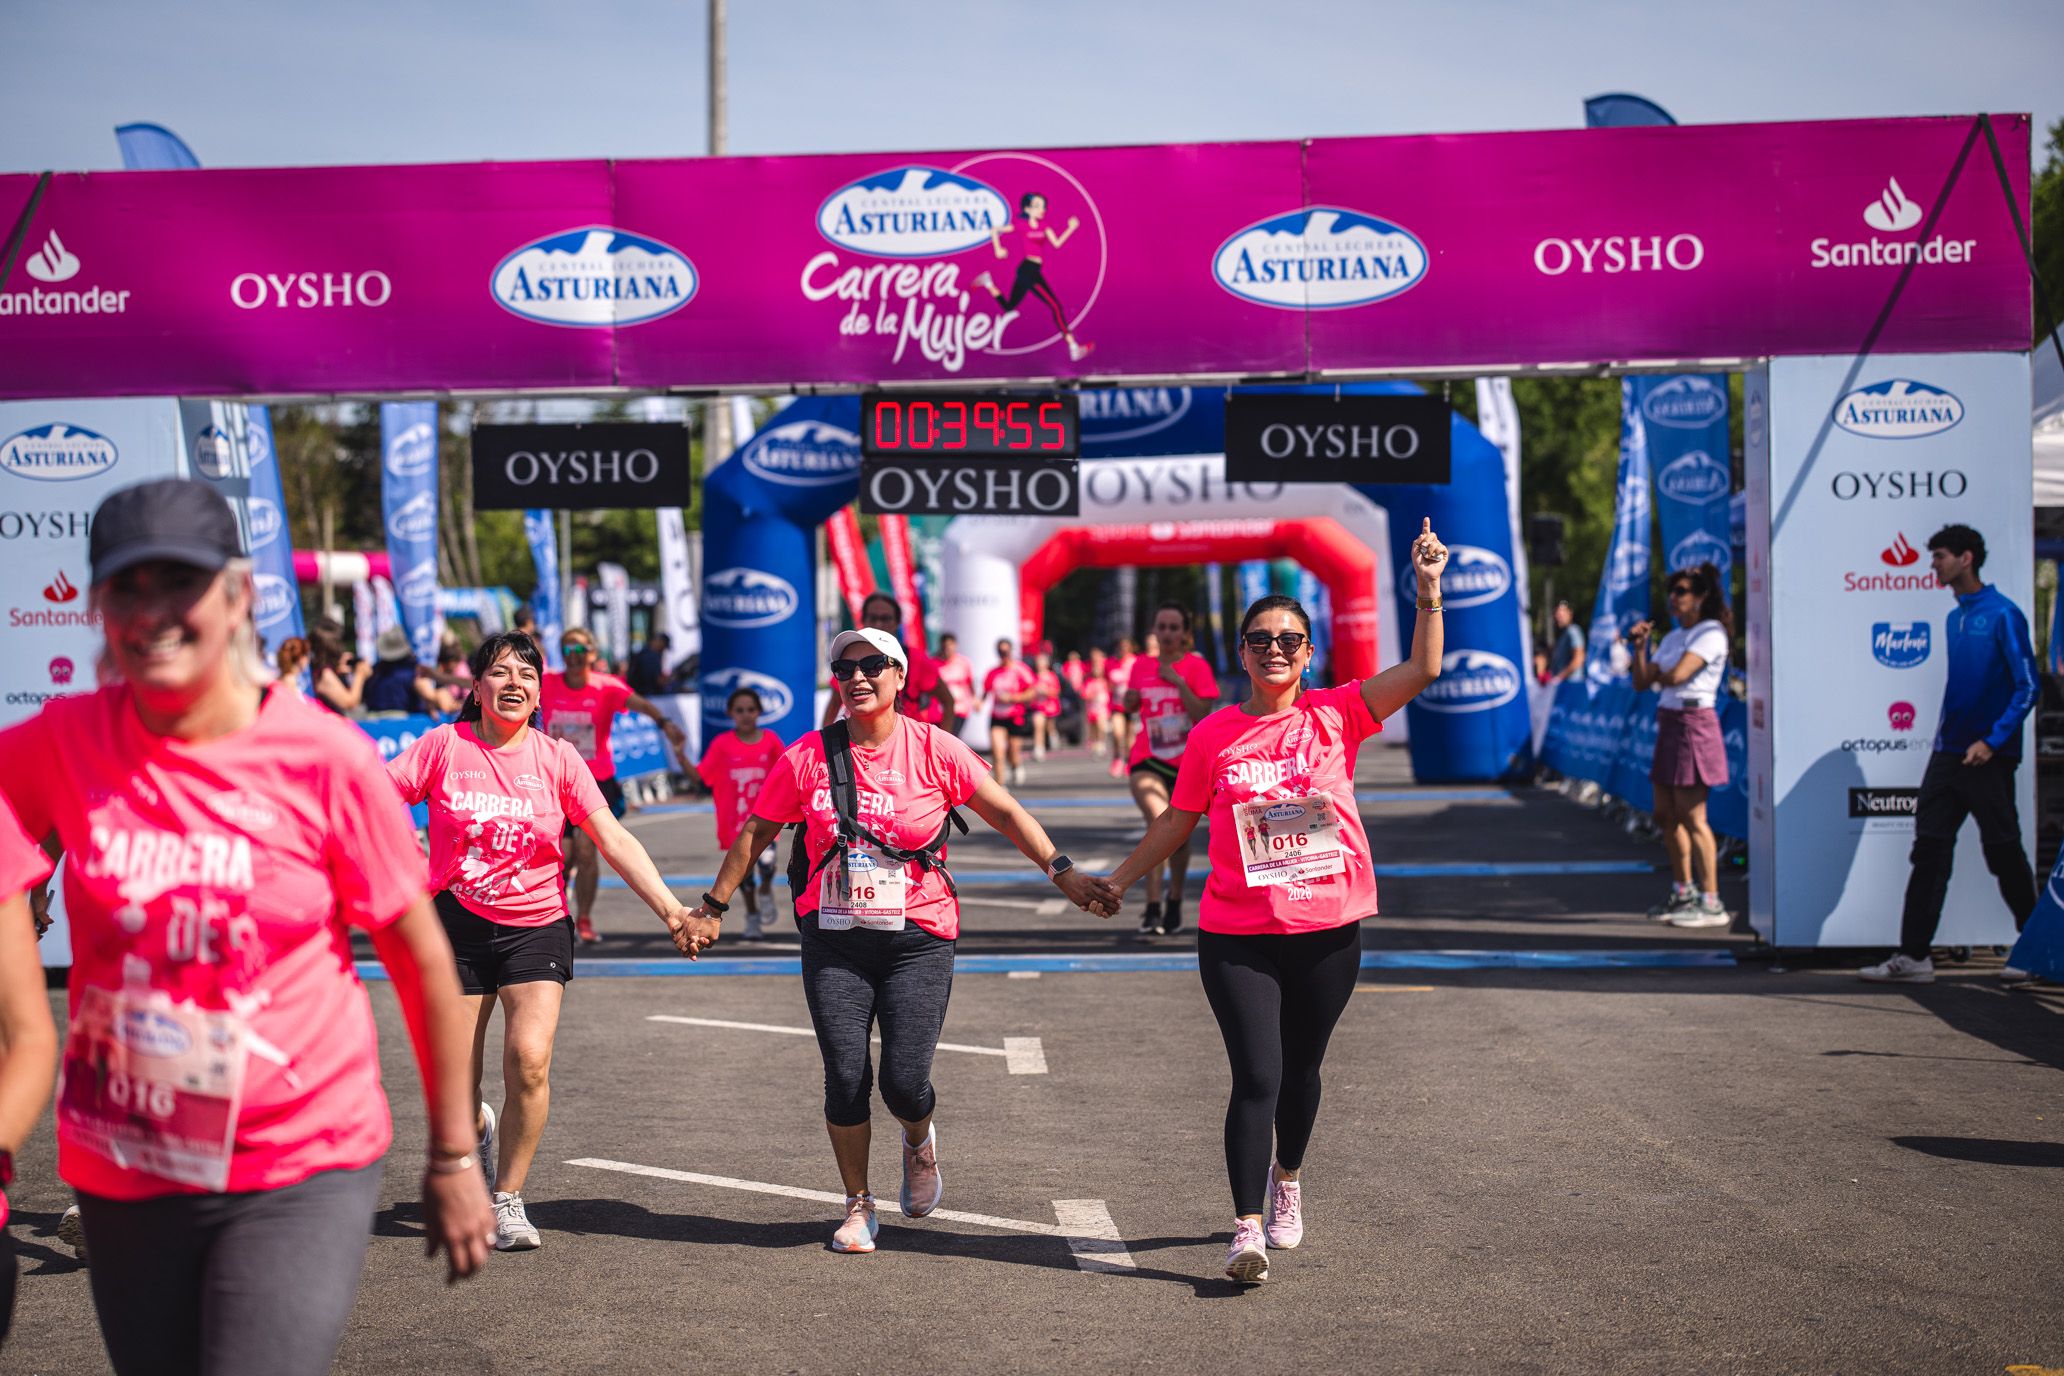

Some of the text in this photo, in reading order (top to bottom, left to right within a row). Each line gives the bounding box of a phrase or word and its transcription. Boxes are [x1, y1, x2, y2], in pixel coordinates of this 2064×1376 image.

[834, 203, 993, 235] ASTURIANA
[1232, 247, 1410, 284] ASTURIANA
[1533, 233, 1705, 275] OYSHO
[1810, 234, 1977, 268] Santander
[229, 269, 392, 310] OYSHO
[510, 266, 681, 301] ASTURIANA
[800, 251, 961, 301] Carrera
[0, 286, 131, 315] antander
[839, 291, 1020, 372] de la Mujer
[1079, 388, 1174, 419] RIANA
[1844, 402, 1954, 424] ASTURIANA
[875, 401, 1065, 450] 00:39:55
[1260, 423, 1420, 459] OYSHO
[7, 445, 109, 467] ASTURIANA
[505, 448, 660, 486] OYSHO
[870, 466, 1071, 511] OYSHO
[1832, 469, 1968, 501] OYSHO
[0, 510, 92, 540] OYSH
[1844, 571, 1946, 592] Santand
[9, 606, 104, 627] Santande
[1221, 743, 1258, 758] OYSHO
[1841, 737, 1908, 754] octopus
[450, 770, 486, 780] OYSHO
[1227, 752, 1311, 785] CARRERA
[450, 790, 536, 819] CARRERA
[812, 788, 896, 817] CAERA
[1268, 809, 1303, 819] ASTURIANA
[1273, 832, 1308, 850] 016
[1284, 850, 1302, 859] 2406
[1248, 864, 1269, 872] CARRERA
[1258, 870, 1288, 881] OYSHO
[1306, 864, 1333, 873] Santander
[827, 918, 851, 926] OYSHO
